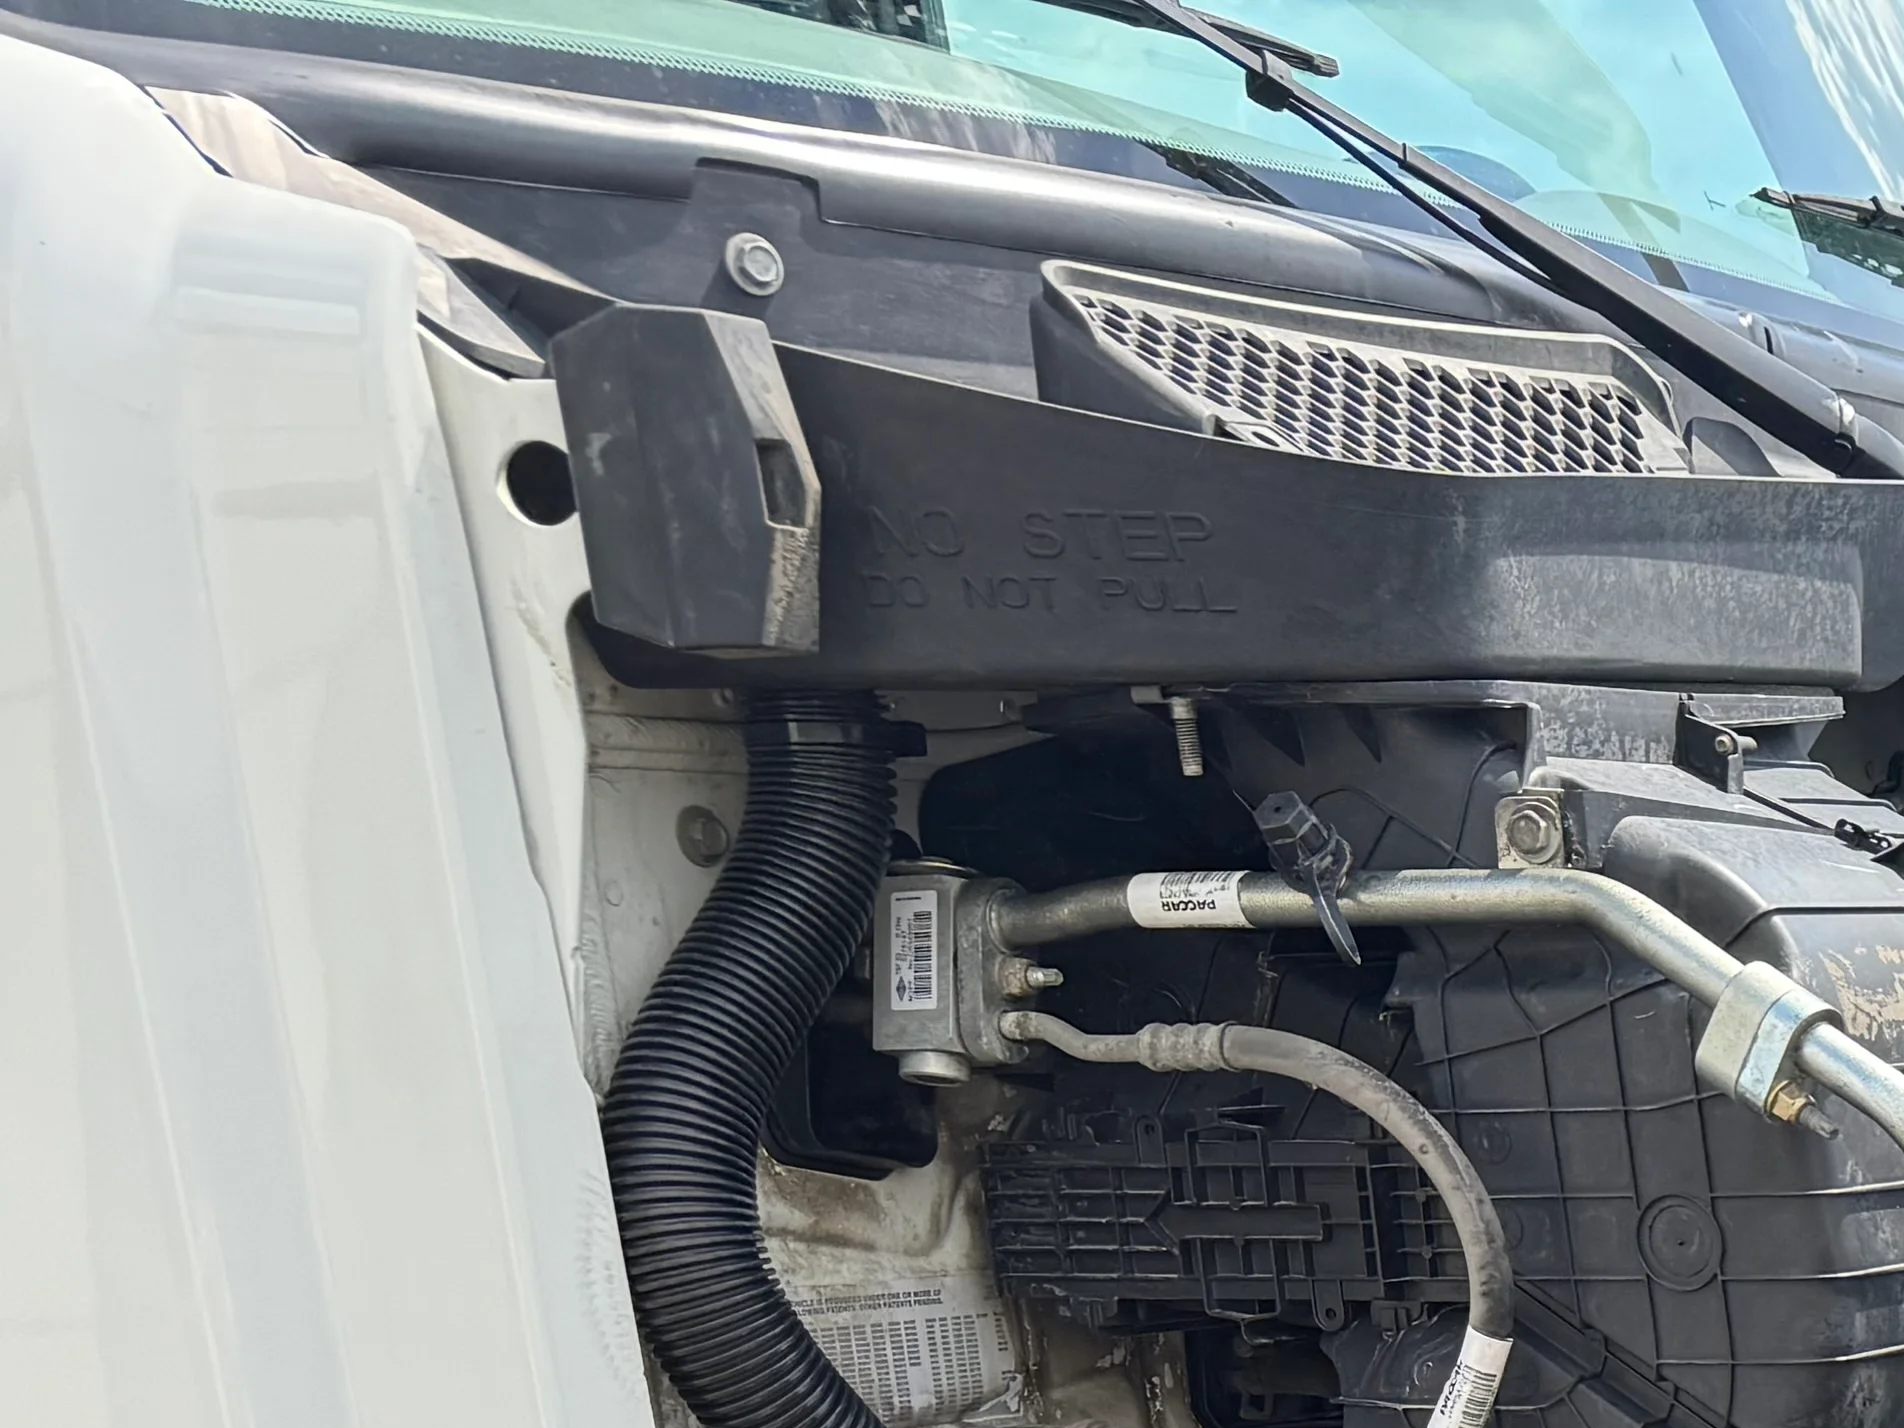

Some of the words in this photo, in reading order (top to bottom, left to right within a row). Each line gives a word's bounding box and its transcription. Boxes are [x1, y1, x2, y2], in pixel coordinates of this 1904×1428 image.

[869, 505, 965, 557] NO
[1020, 508, 1213, 562] STEP
[862, 573, 930, 608] DO
[962, 574, 1058, 610] NOT
[1100, 576, 1237, 613] PULL
[1160, 899, 1217, 912] PACCAR
